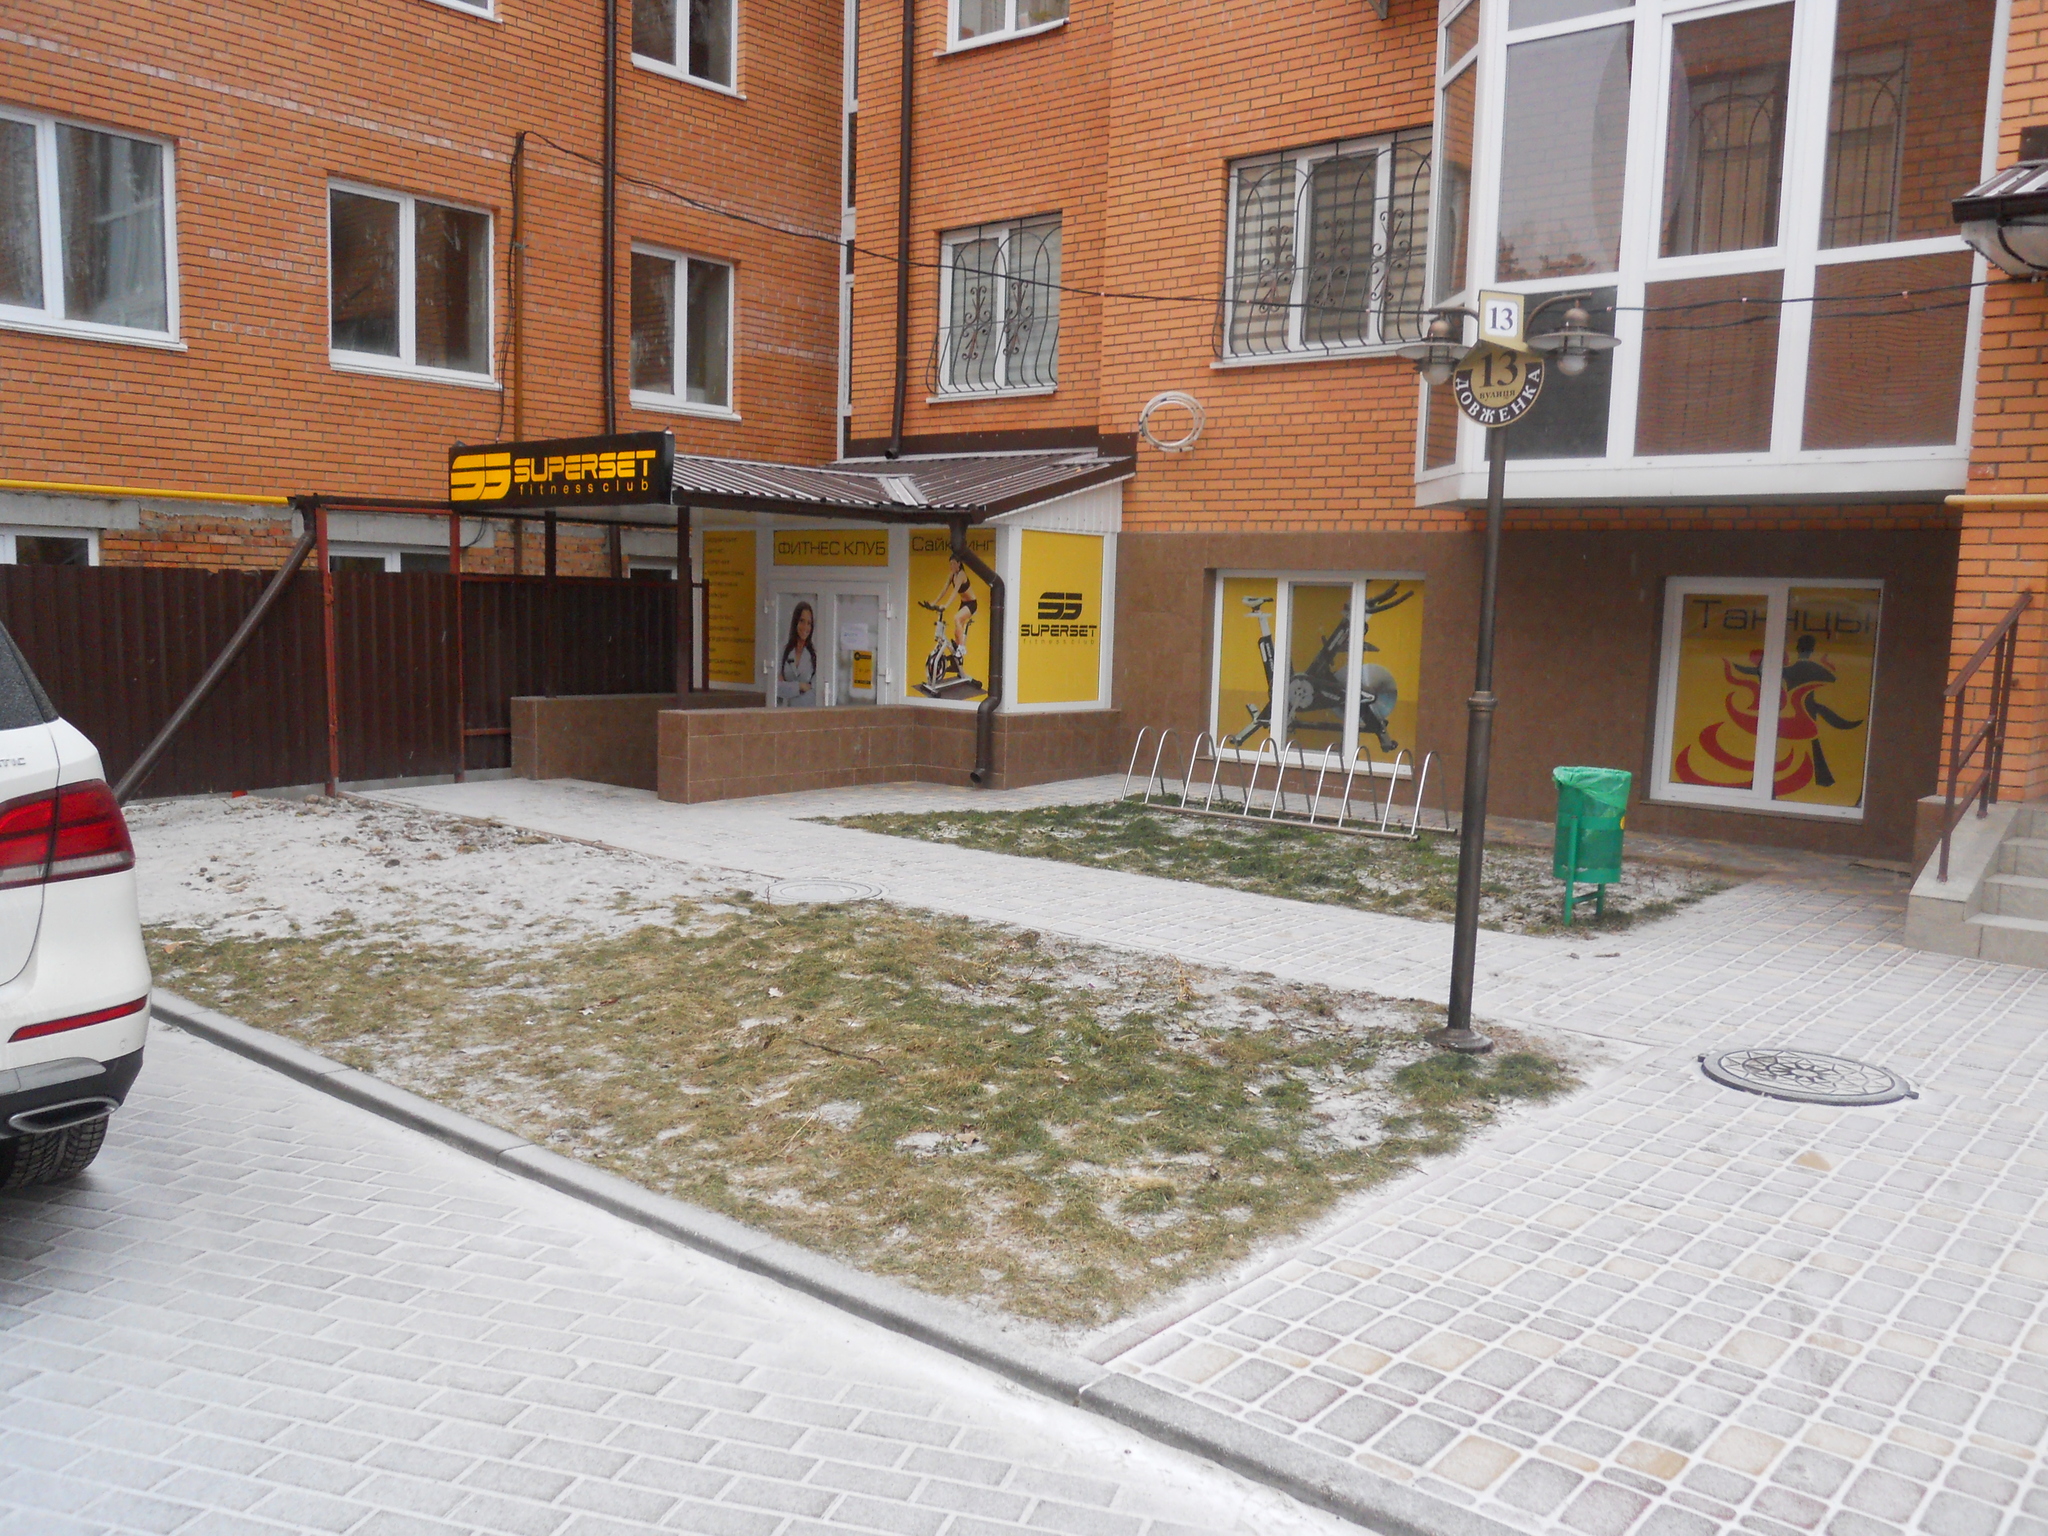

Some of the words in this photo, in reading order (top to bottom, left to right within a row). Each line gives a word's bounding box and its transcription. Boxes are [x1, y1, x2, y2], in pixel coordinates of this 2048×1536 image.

[1489, 306, 1514, 331] 13
[1479, 351, 1519, 388] 13
[1455, 368, 1541, 423] ДОВЖЕНКА
[514, 450, 656, 482] SUPERSET
[519, 483, 594, 495] fitness
[602, 479, 649, 492] club
[778, 541, 840, 556] ФИТНЕС
[844, 541, 886, 556] КЛУБ
[912, 536, 994, 552] Сайкинг
[1021, 624, 1097, 637] SUPERSET
[1692, 600, 1871, 639] Танцы
